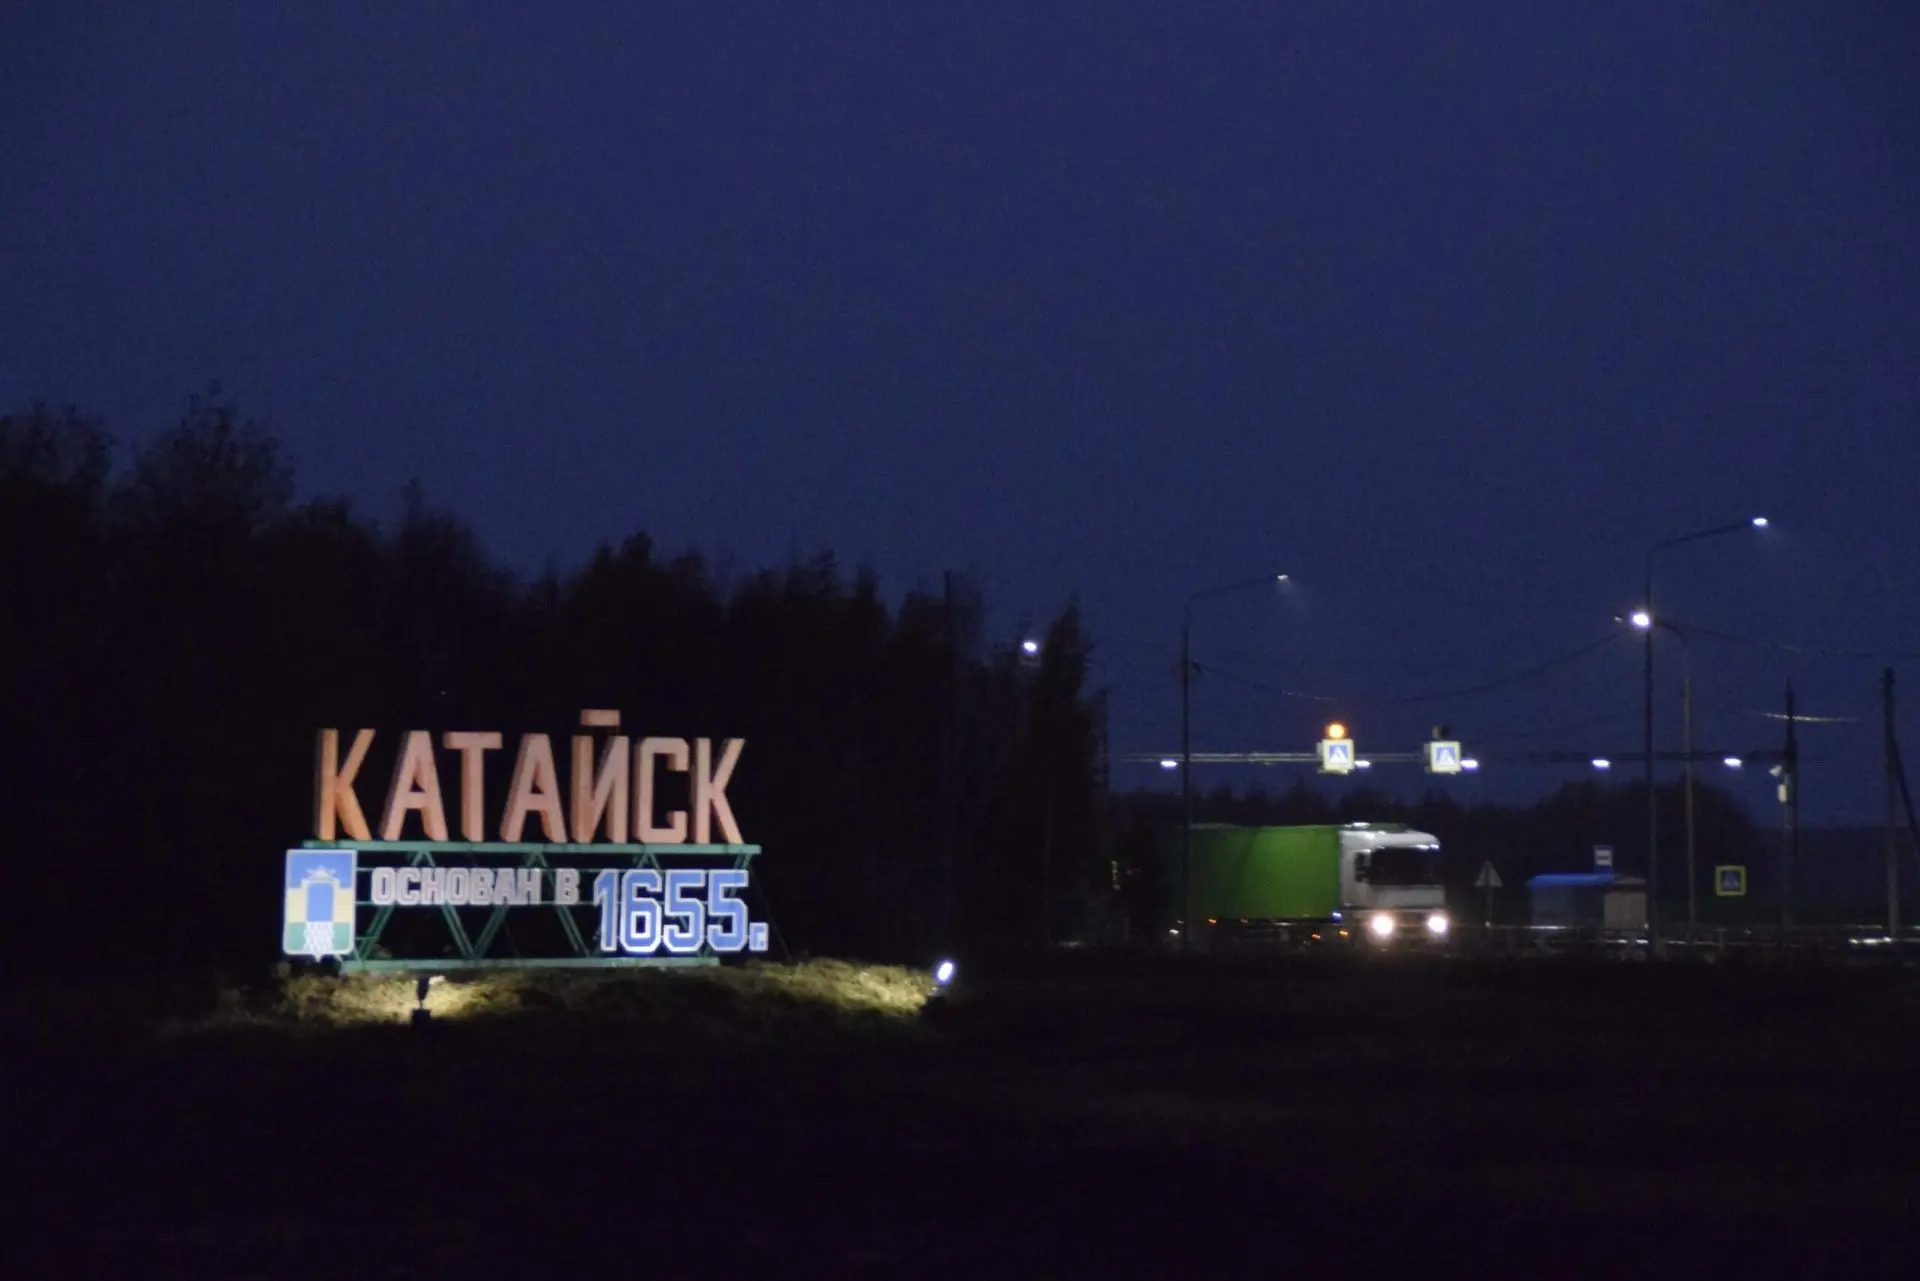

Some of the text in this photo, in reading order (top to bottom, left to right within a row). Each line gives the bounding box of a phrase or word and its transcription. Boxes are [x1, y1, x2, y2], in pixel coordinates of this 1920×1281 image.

[314, 709, 746, 844] КАТАЙСК
[371, 867, 541, 905] ОСНОВАН
[554, 868, 580, 905] В
